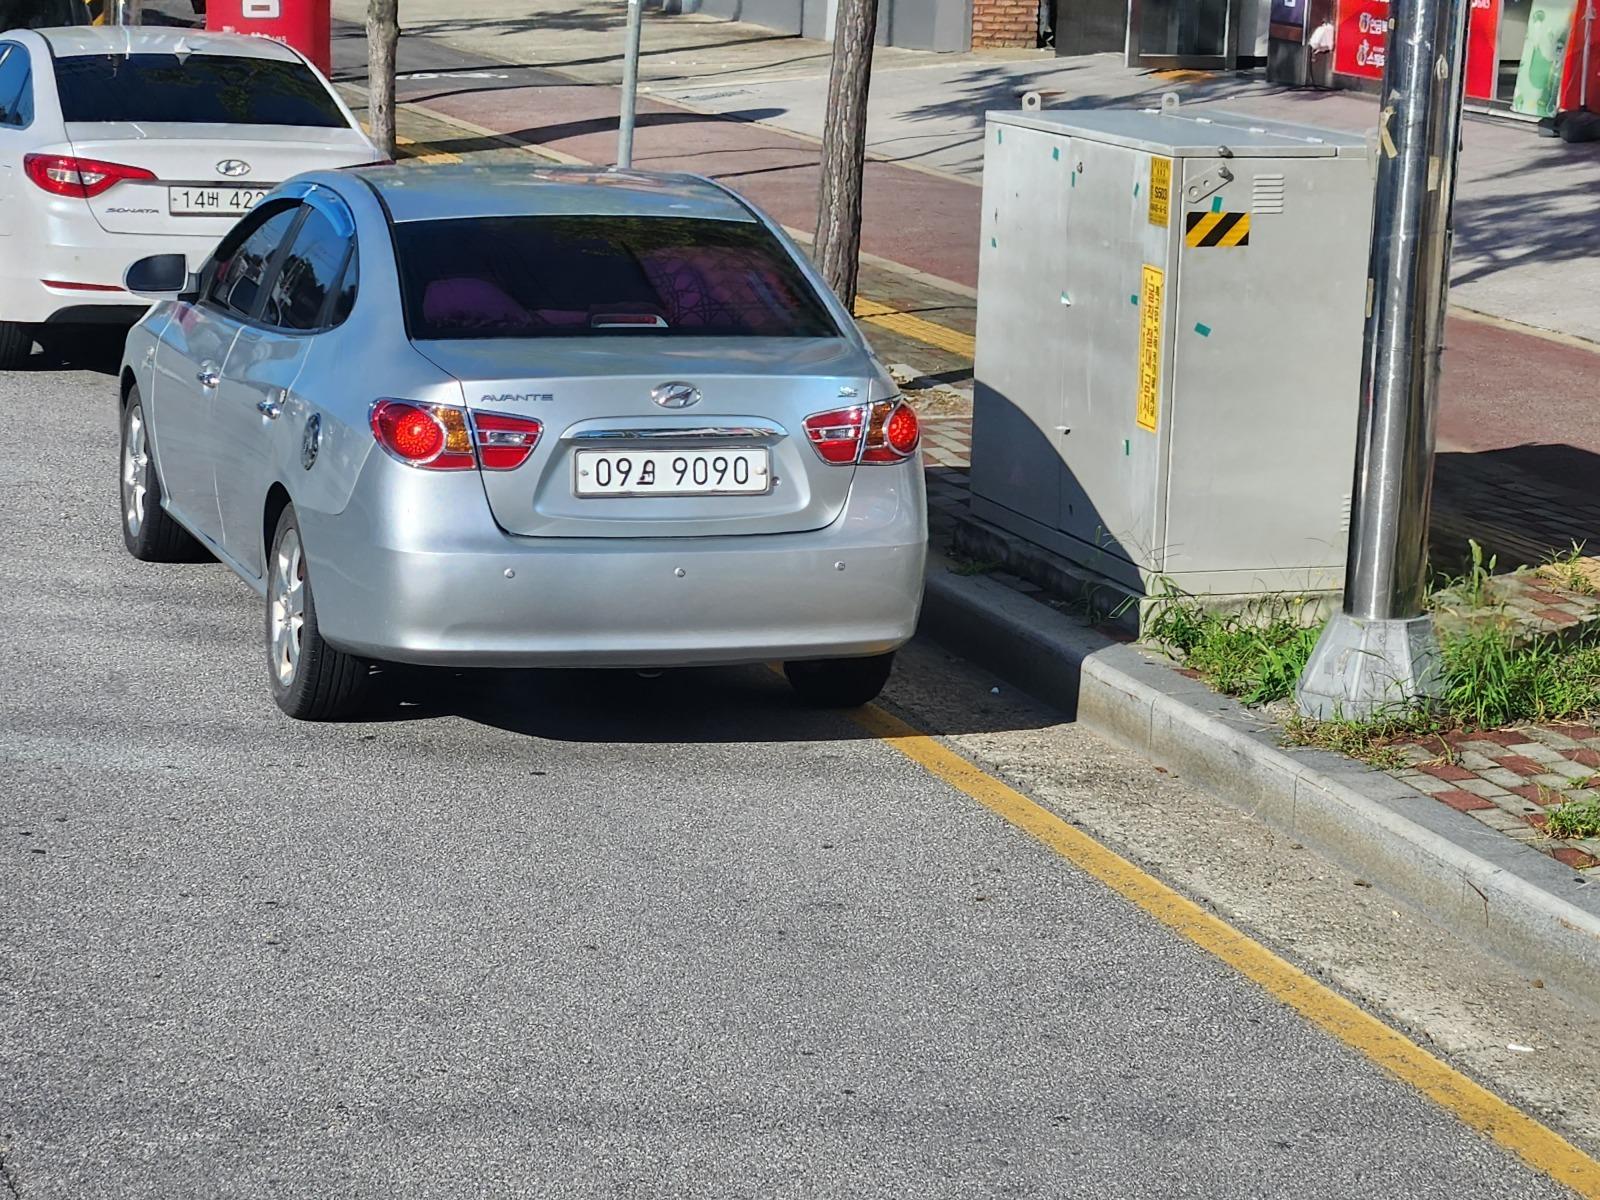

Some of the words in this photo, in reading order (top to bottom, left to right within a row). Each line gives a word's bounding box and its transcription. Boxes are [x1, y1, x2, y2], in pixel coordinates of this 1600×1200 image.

[182, 190, 219, 208] 14버
[480, 393, 554, 402] AVANTE
[672, 455, 750, 486] 9090
